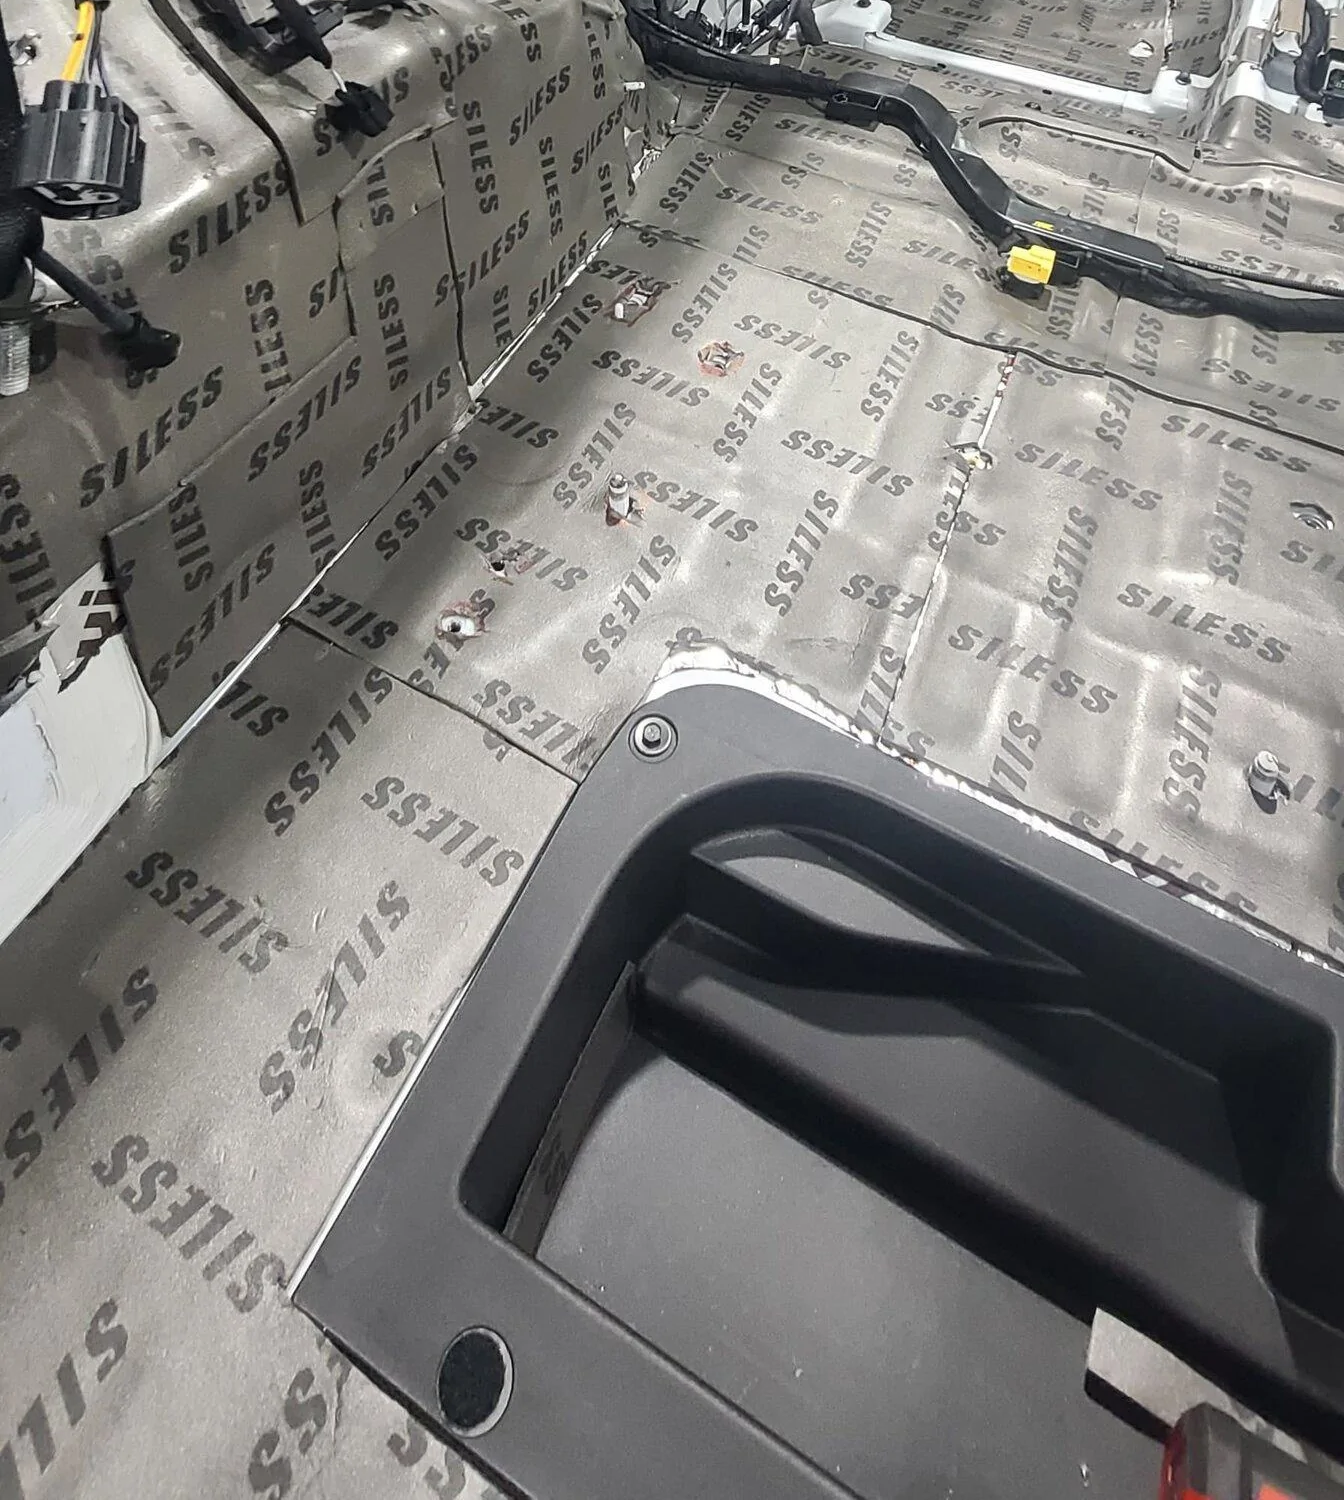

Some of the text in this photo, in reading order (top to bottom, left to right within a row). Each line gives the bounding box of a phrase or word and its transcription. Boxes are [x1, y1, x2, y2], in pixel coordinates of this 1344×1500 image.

[509, 65, 573, 146] SILESS
[572, 101, 624, 175] SILESS
[726, 94, 771, 142] SILESS
[463, 100, 498, 214] SILESS
[539, 136, 563, 237] SILESS
[598, 163, 620, 222] SILE
[659, 152, 714, 214] SILESS
[715, 186, 823, 225] SILESS
[168, 160, 290, 274] SILESS
[845, 201, 892, 268] SILESS
[493, 284, 515, 348] SILE
[528, 230, 587, 317] SILESS
[672, 262, 738, 343] SILESS
[244, 279, 291, 392] ILESS
[373, 273, 409, 391] SILESS
[528, 294, 602, 382] SILESS
[592, 350, 710, 407] SILESS
[734, 315, 851, 369] SILESS
[860, 331, 919, 422] SILESS
[80, 366, 224, 508] SILESS
[247, 355, 361, 482] SILESS
[362, 366, 450, 478] SILESS
[553, 402, 637, 509] SILESS
[713, 362, 783, 463] SILESS
[781, 430, 914, 496] SILESS
[1160, 415, 1311, 473] SILESS
[375, 445, 478, 561] SILESS
[1014, 443, 1163, 511] SILESS
[1207, 470, 1252, 585] SILESS
[765, 489, 839, 617] SILESS
[1041, 505, 1098, 631] SILESS
[150, 543, 275, 697] SILESS
[582, 535, 676, 674] SILESS
[1117, 583, 1290, 663] SILESS
[948, 624, 1118, 713] SILESS
[264, 668, 393, 838] SILESS
[1162, 660, 1221, 816] SILESS
[360, 776, 525, 888] SILESS
[125, 851, 289, 974] SILESS
[92, 1134, 287, 1314] SILESS
